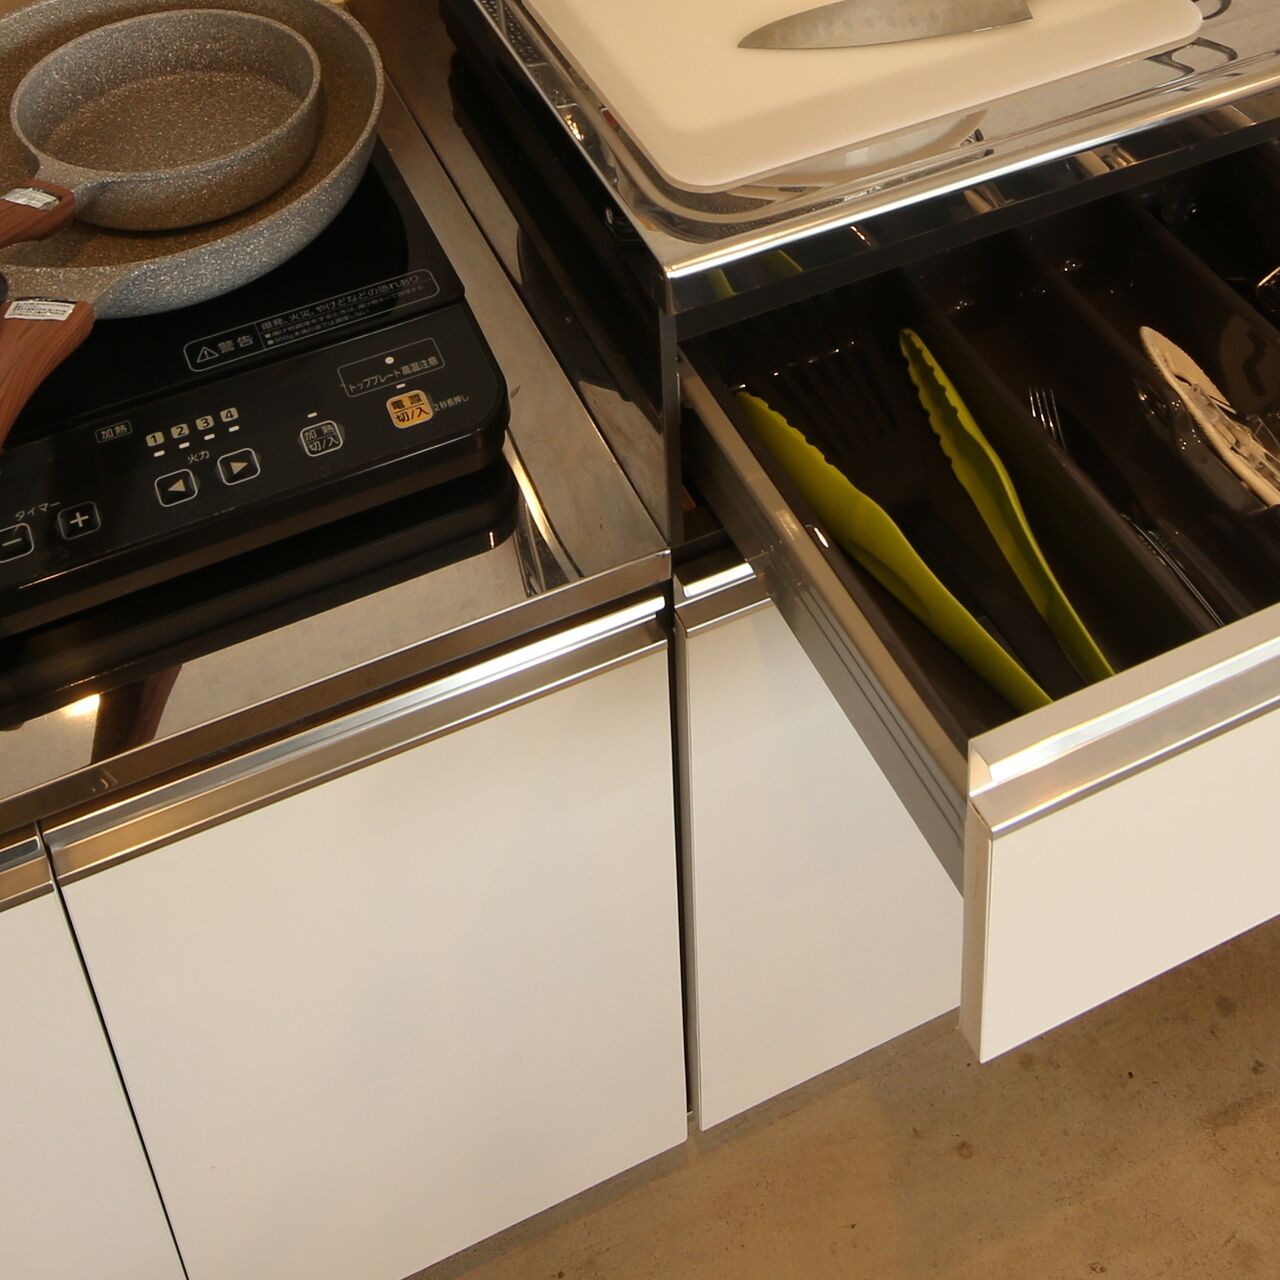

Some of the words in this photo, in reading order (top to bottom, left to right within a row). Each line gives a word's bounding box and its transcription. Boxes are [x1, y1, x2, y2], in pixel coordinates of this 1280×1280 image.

[391, 393, 424, 410] 電源
[223, 409, 235, 420] 4
[200, 417, 211, 428] 3
[175, 426, 186, 437] 2
[187, 450, 210, 465] 火力
[14, 501, 62, 521] タイマー
